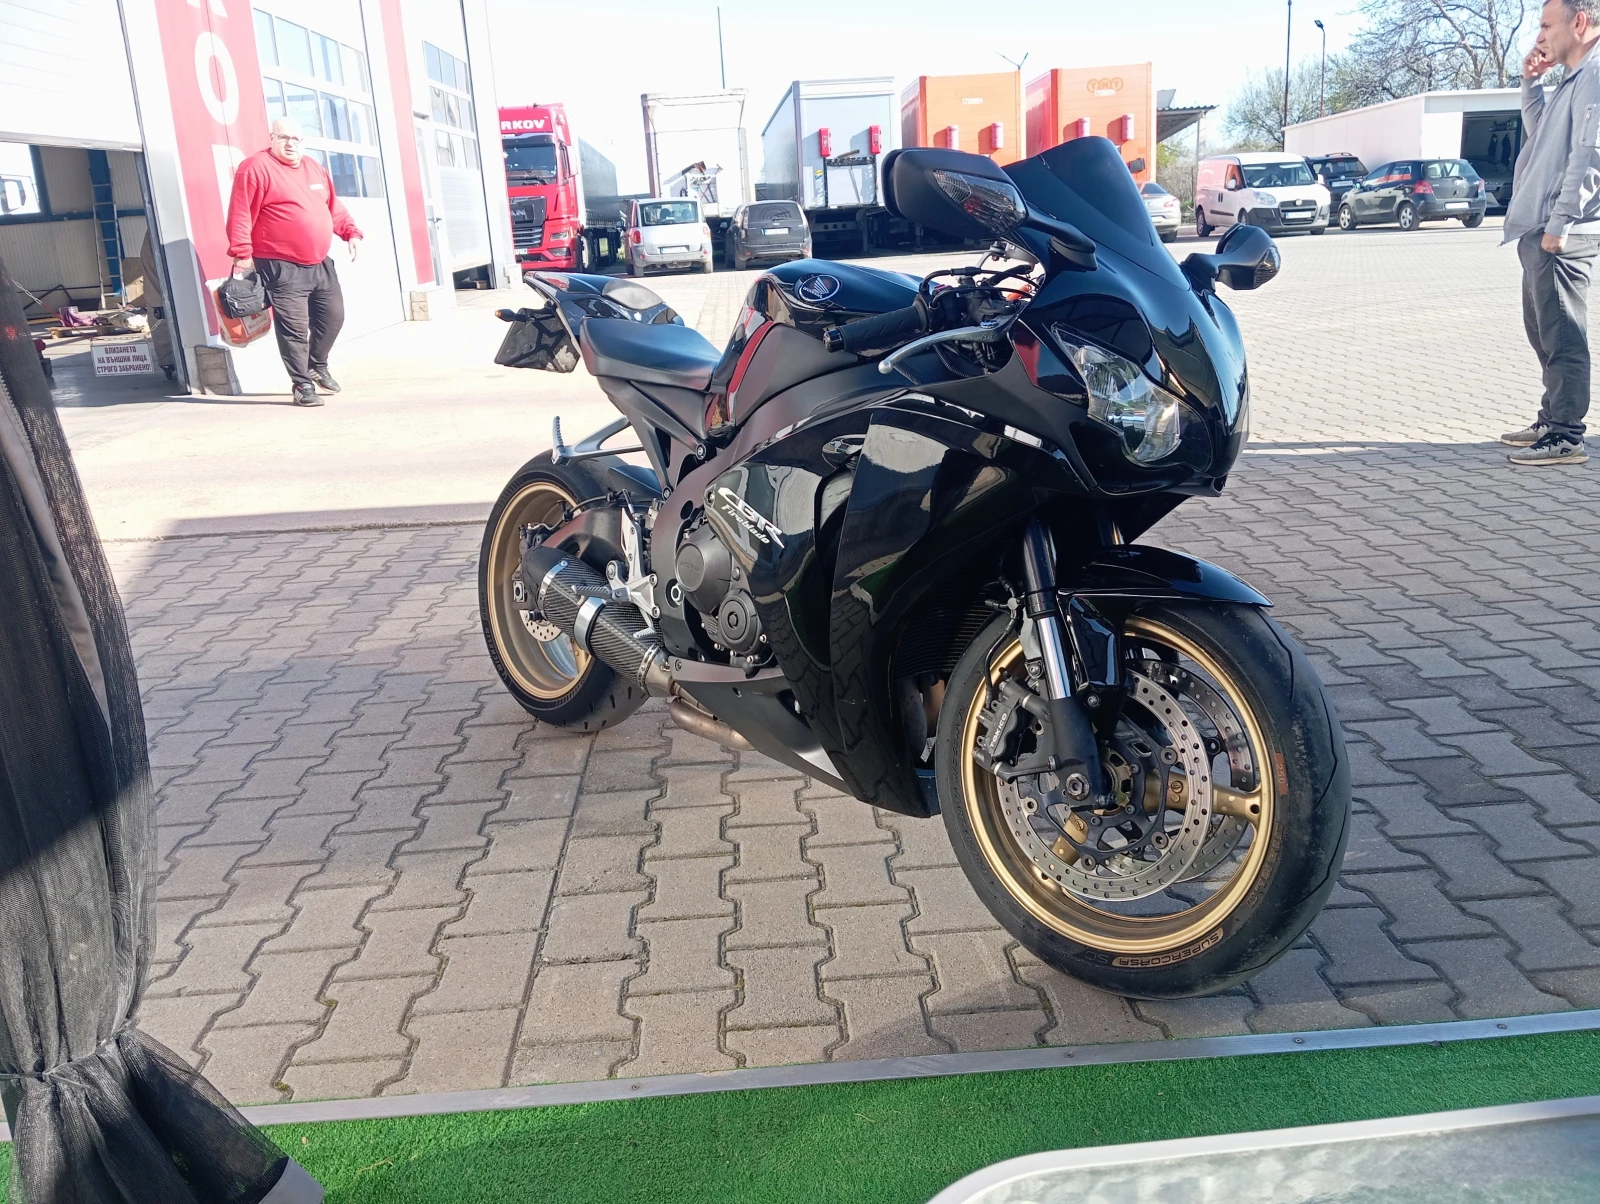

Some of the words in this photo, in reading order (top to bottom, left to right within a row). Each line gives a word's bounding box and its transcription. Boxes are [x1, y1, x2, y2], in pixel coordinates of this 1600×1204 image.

[500, 120, 545, 130] RKOV
[104, 346, 137, 354] ВЛИЗАНЕТО
[718, 487, 785, 548] CBR
[990, 713, 1007, 747] TOKICO
[1119, 933, 1219, 966] SUPERCORSA
